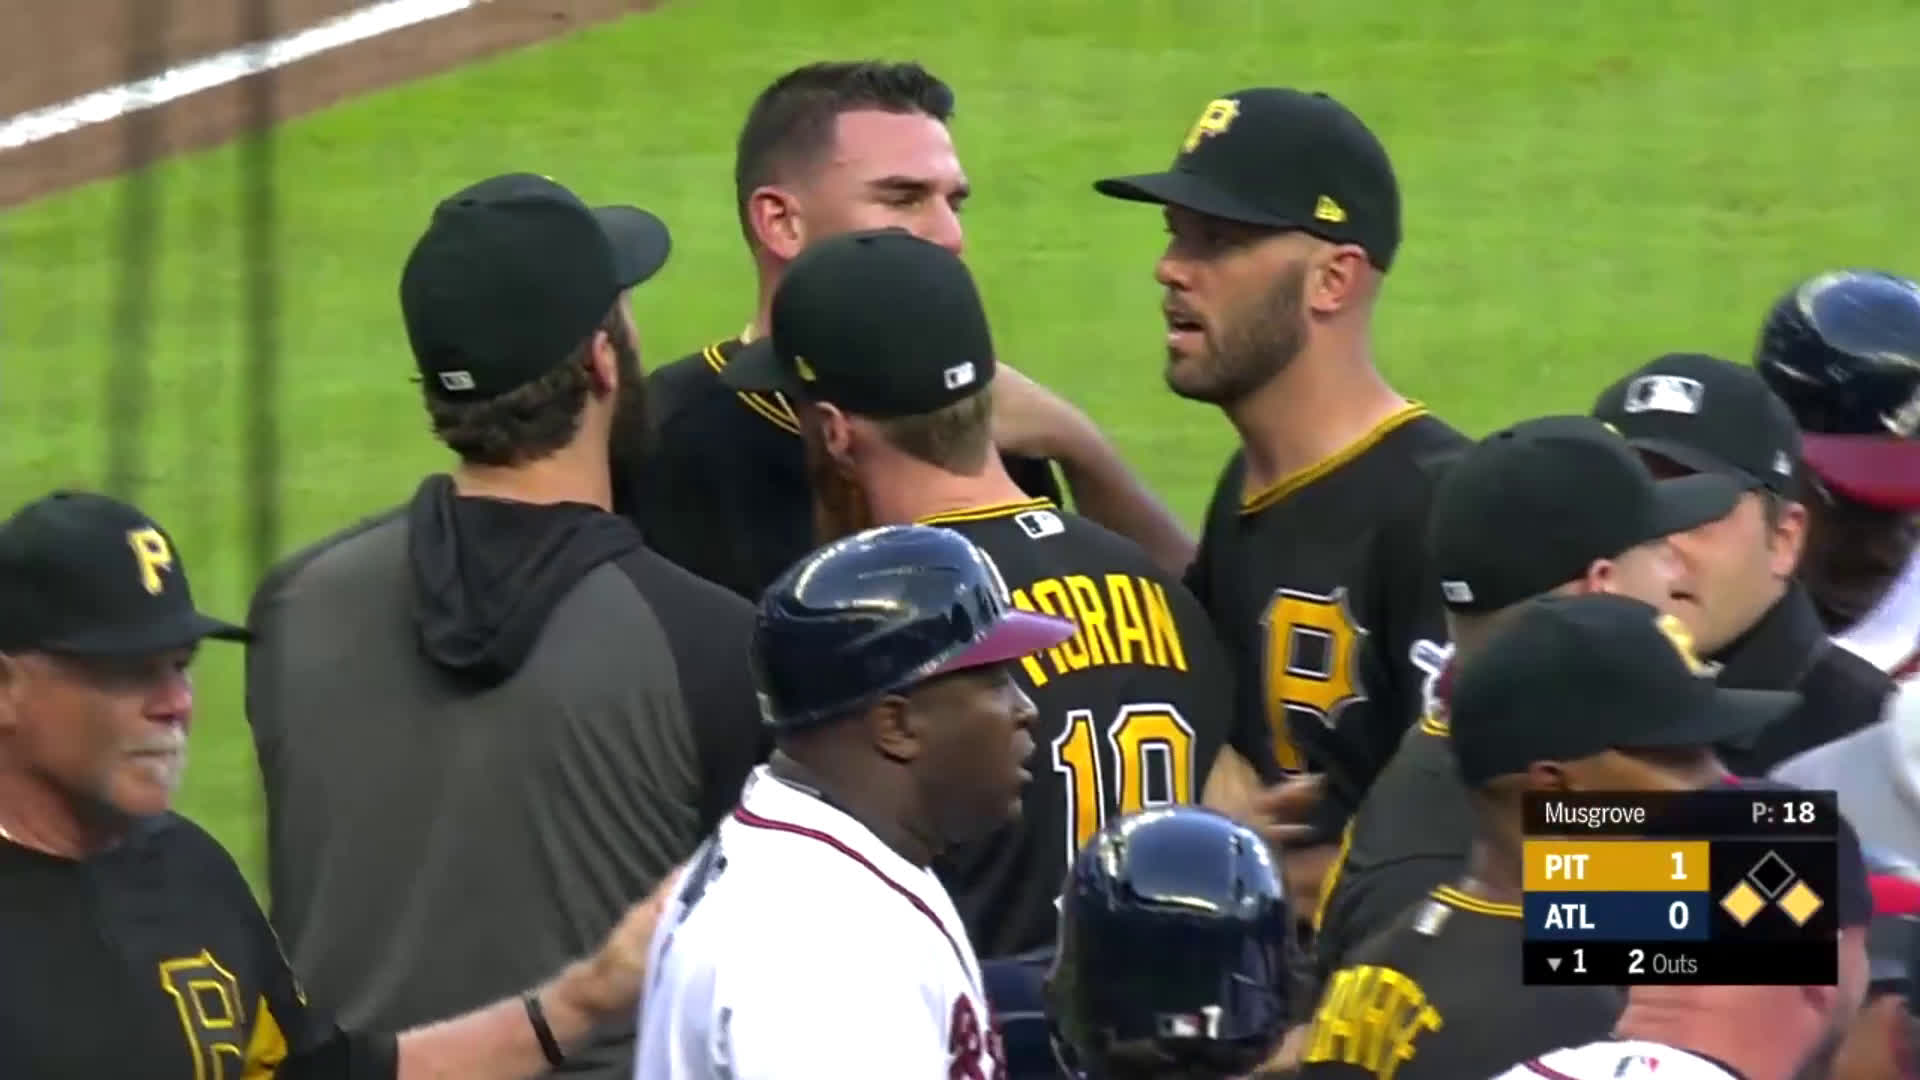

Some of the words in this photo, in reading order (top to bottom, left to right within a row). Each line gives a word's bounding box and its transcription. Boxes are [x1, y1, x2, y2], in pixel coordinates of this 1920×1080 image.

[1184, 98, 1240, 153] P
[126, 530, 174, 596] P
[1259, 584, 1371, 779] P
